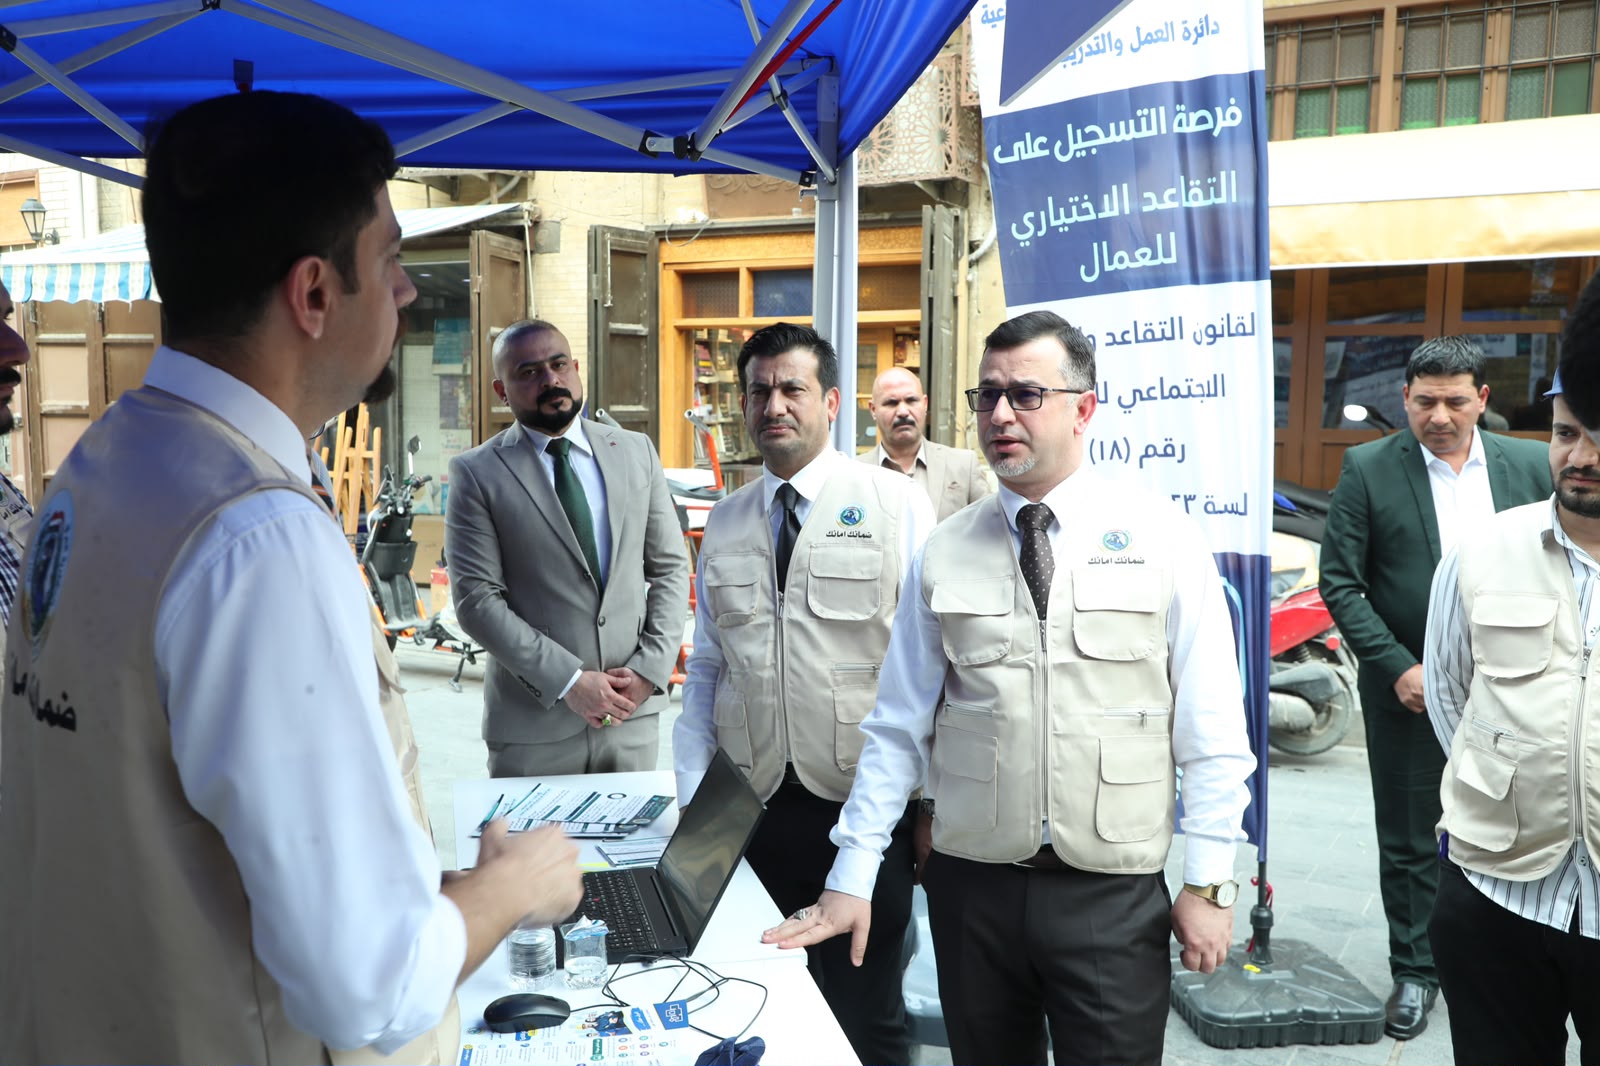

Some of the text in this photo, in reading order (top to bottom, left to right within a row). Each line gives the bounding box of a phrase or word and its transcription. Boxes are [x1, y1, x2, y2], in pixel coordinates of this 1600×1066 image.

[1130, 21, 1175, 53] العمل
[1182, 14, 1220, 46] دائرة
[993, 97, 1242, 164] فرصة التسجيل على
[1011, 170, 1237, 247] التقاعد الاختياري
[1080, 231, 1177, 283] للعمال
[1105, 316, 1183, 346] التقاعد
[1193, 312, 1256, 346] لقانون
[1117, 373, 1226, 415] الاجتماعي
[1139, 437, 1186, 468] رقم
